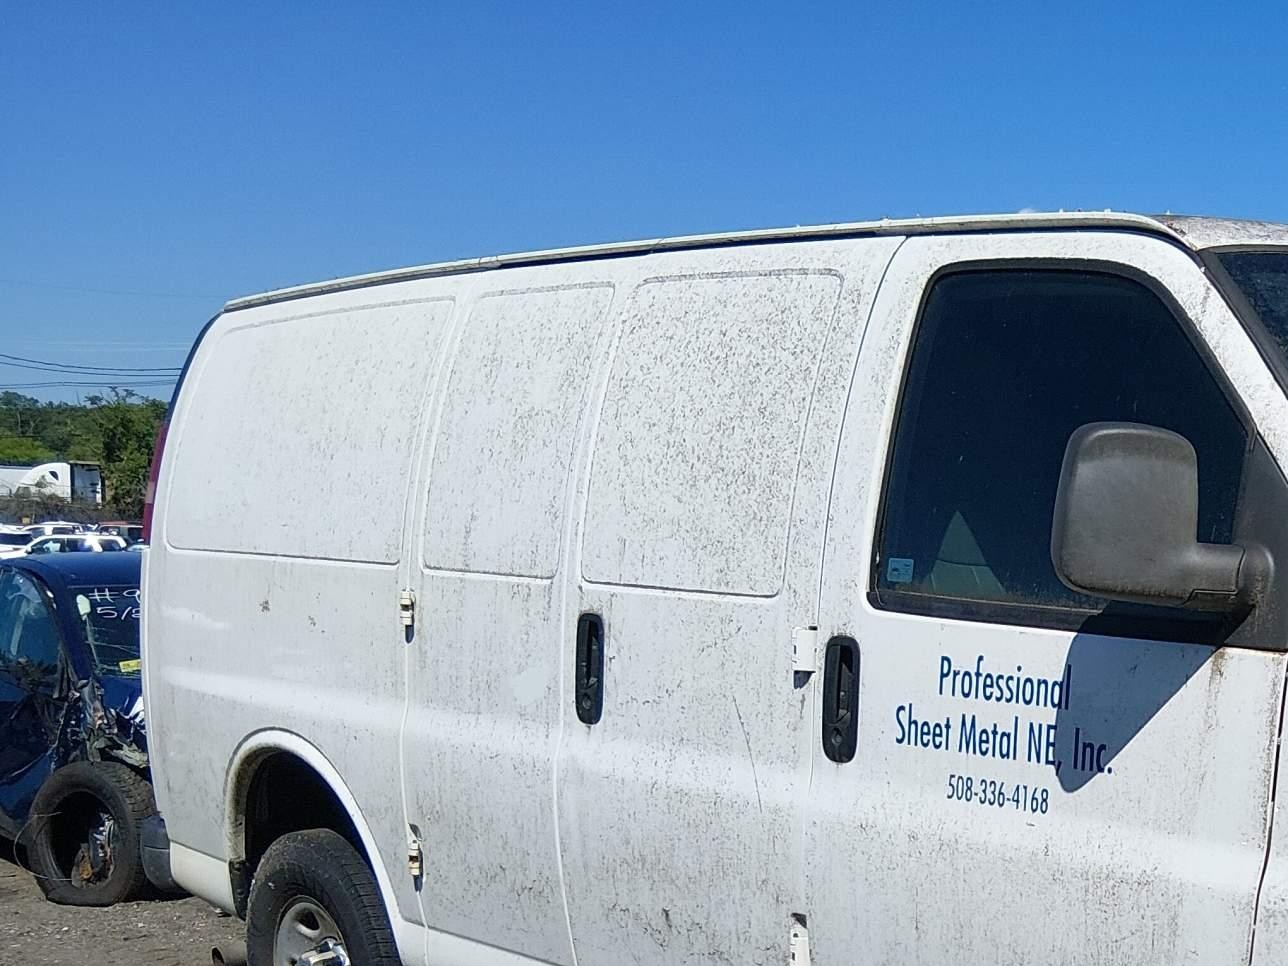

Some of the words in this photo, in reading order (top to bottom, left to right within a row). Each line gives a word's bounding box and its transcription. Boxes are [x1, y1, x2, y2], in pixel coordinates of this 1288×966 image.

[939, 655, 1072, 710] Professional
[895, 703, 951, 751] Sheet
[958, 713, 1018, 761] Metal
[1027, 722, 1062, 776] NE,
[1073, 727, 1113, 775] Inc.
[946, 774, 1049, 814] 508-336-4168
